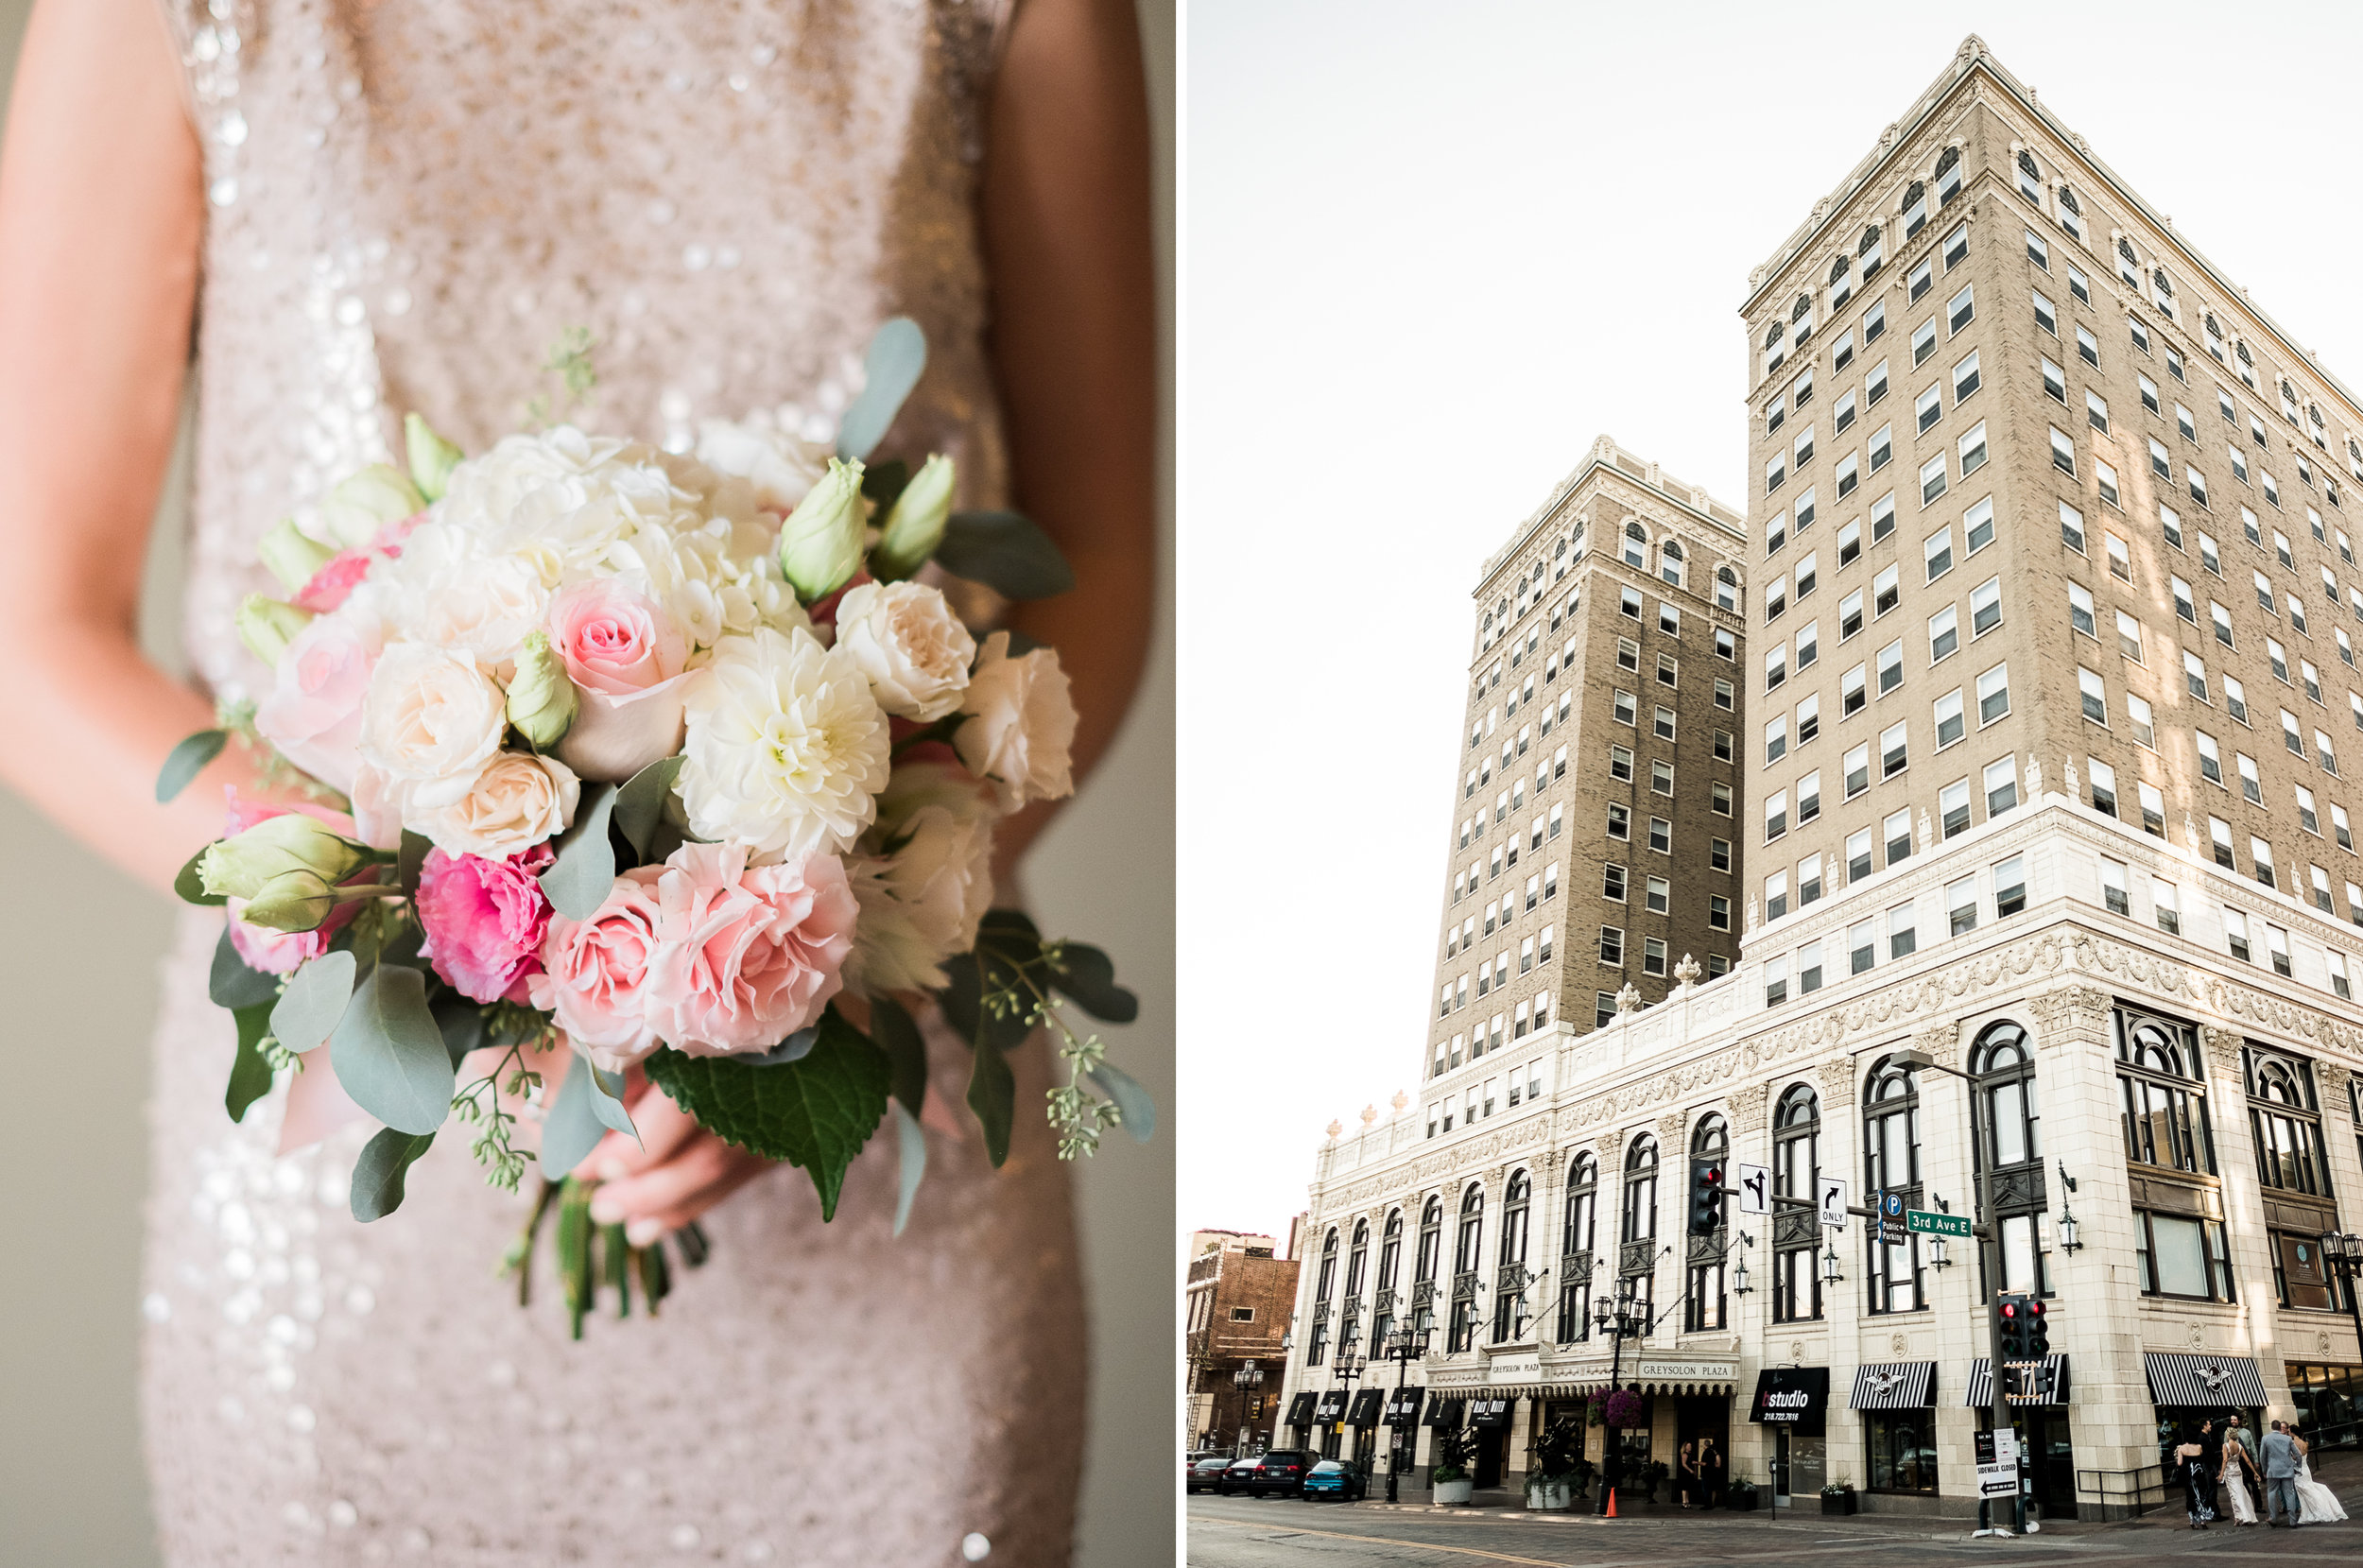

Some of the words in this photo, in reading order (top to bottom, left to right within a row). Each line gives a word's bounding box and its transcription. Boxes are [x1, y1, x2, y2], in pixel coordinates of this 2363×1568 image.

[1890, 1197, 1898, 1214] P
[1822, 1211, 1844, 1222] ONLY
[1882, 1221, 1900, 1232] Public
[1912, 1215, 1931, 1229] 3rd
[1936, 1218, 1957, 1232] Ave
[1960, 1221, 1967, 1232] E
[1882, 1232, 1903, 1243] Parking
[1493, 1365, 1521, 1374] GREYSOLON
[1524, 1363, 1540, 1371] PLAZA
[1643, 1365, 1697, 1375] GREYSOLON
[1702, 1367, 1729, 1376] PLAZA
[1762, 1390, 1809, 1407] bstudio
[1977, 1465, 1999, 1475] SIDEWALK
[2000, 1463, 2017, 1473] CLOSED
